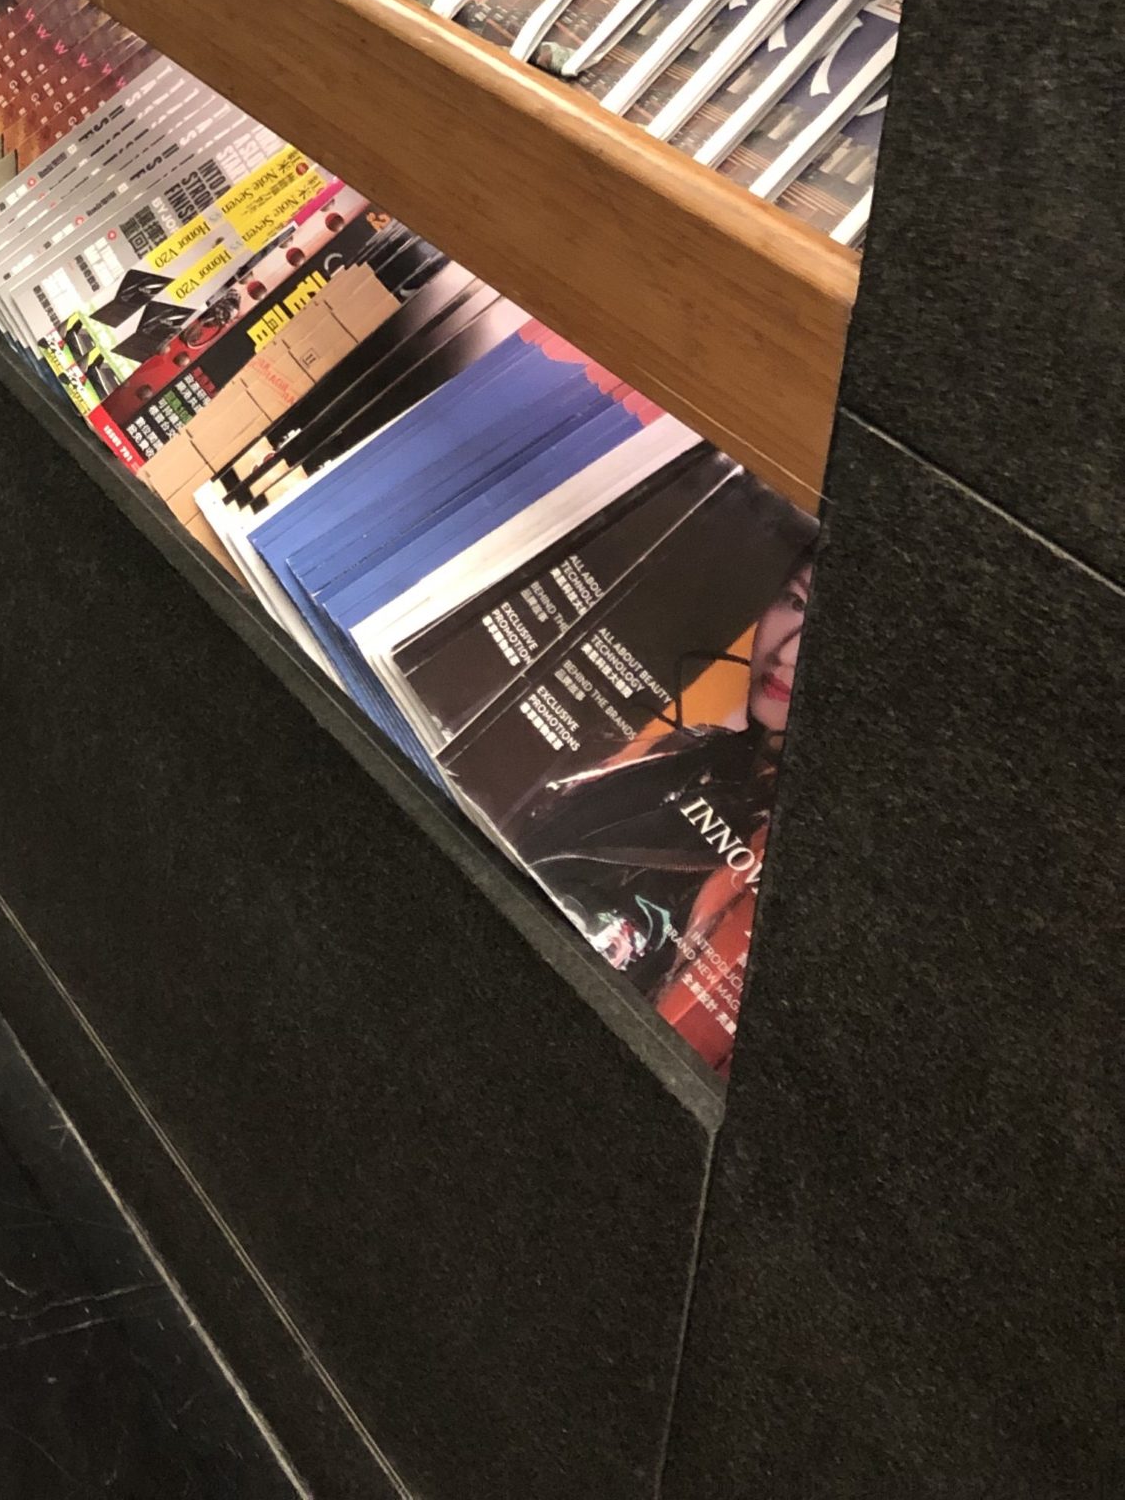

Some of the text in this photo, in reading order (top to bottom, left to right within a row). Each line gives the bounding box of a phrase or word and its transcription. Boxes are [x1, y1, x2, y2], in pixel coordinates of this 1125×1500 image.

[196, 158, 227, 191] INTO
[250, 168, 278, 194] Note
[220, 187, 254, 217] Seven
[271, 194, 299, 220] Note
[176, 220, 210, 250] Honor
[240, 214, 275, 245] Seven
[153, 246, 178, 269] V20
[197, 249, 231, 279] Honor
[173, 275, 200, 300] V20
[530, 579, 558, 615] BEHIND
[500, 600, 538, 652] EXCLUSIVE
[589, 633, 645, 693] TECHNOLOGY
[611, 640, 642, 673] ABOUT
[638, 669, 672, 705] BEAUTY
[535, 684, 580, 732] EXCLUSIVE
[562, 658, 594, 693] BEHIND
[604, 705, 637, 741] BRANDS
[526, 692, 582, 752] PROMOTIONS
[661, 922, 697, 962] BRAND
